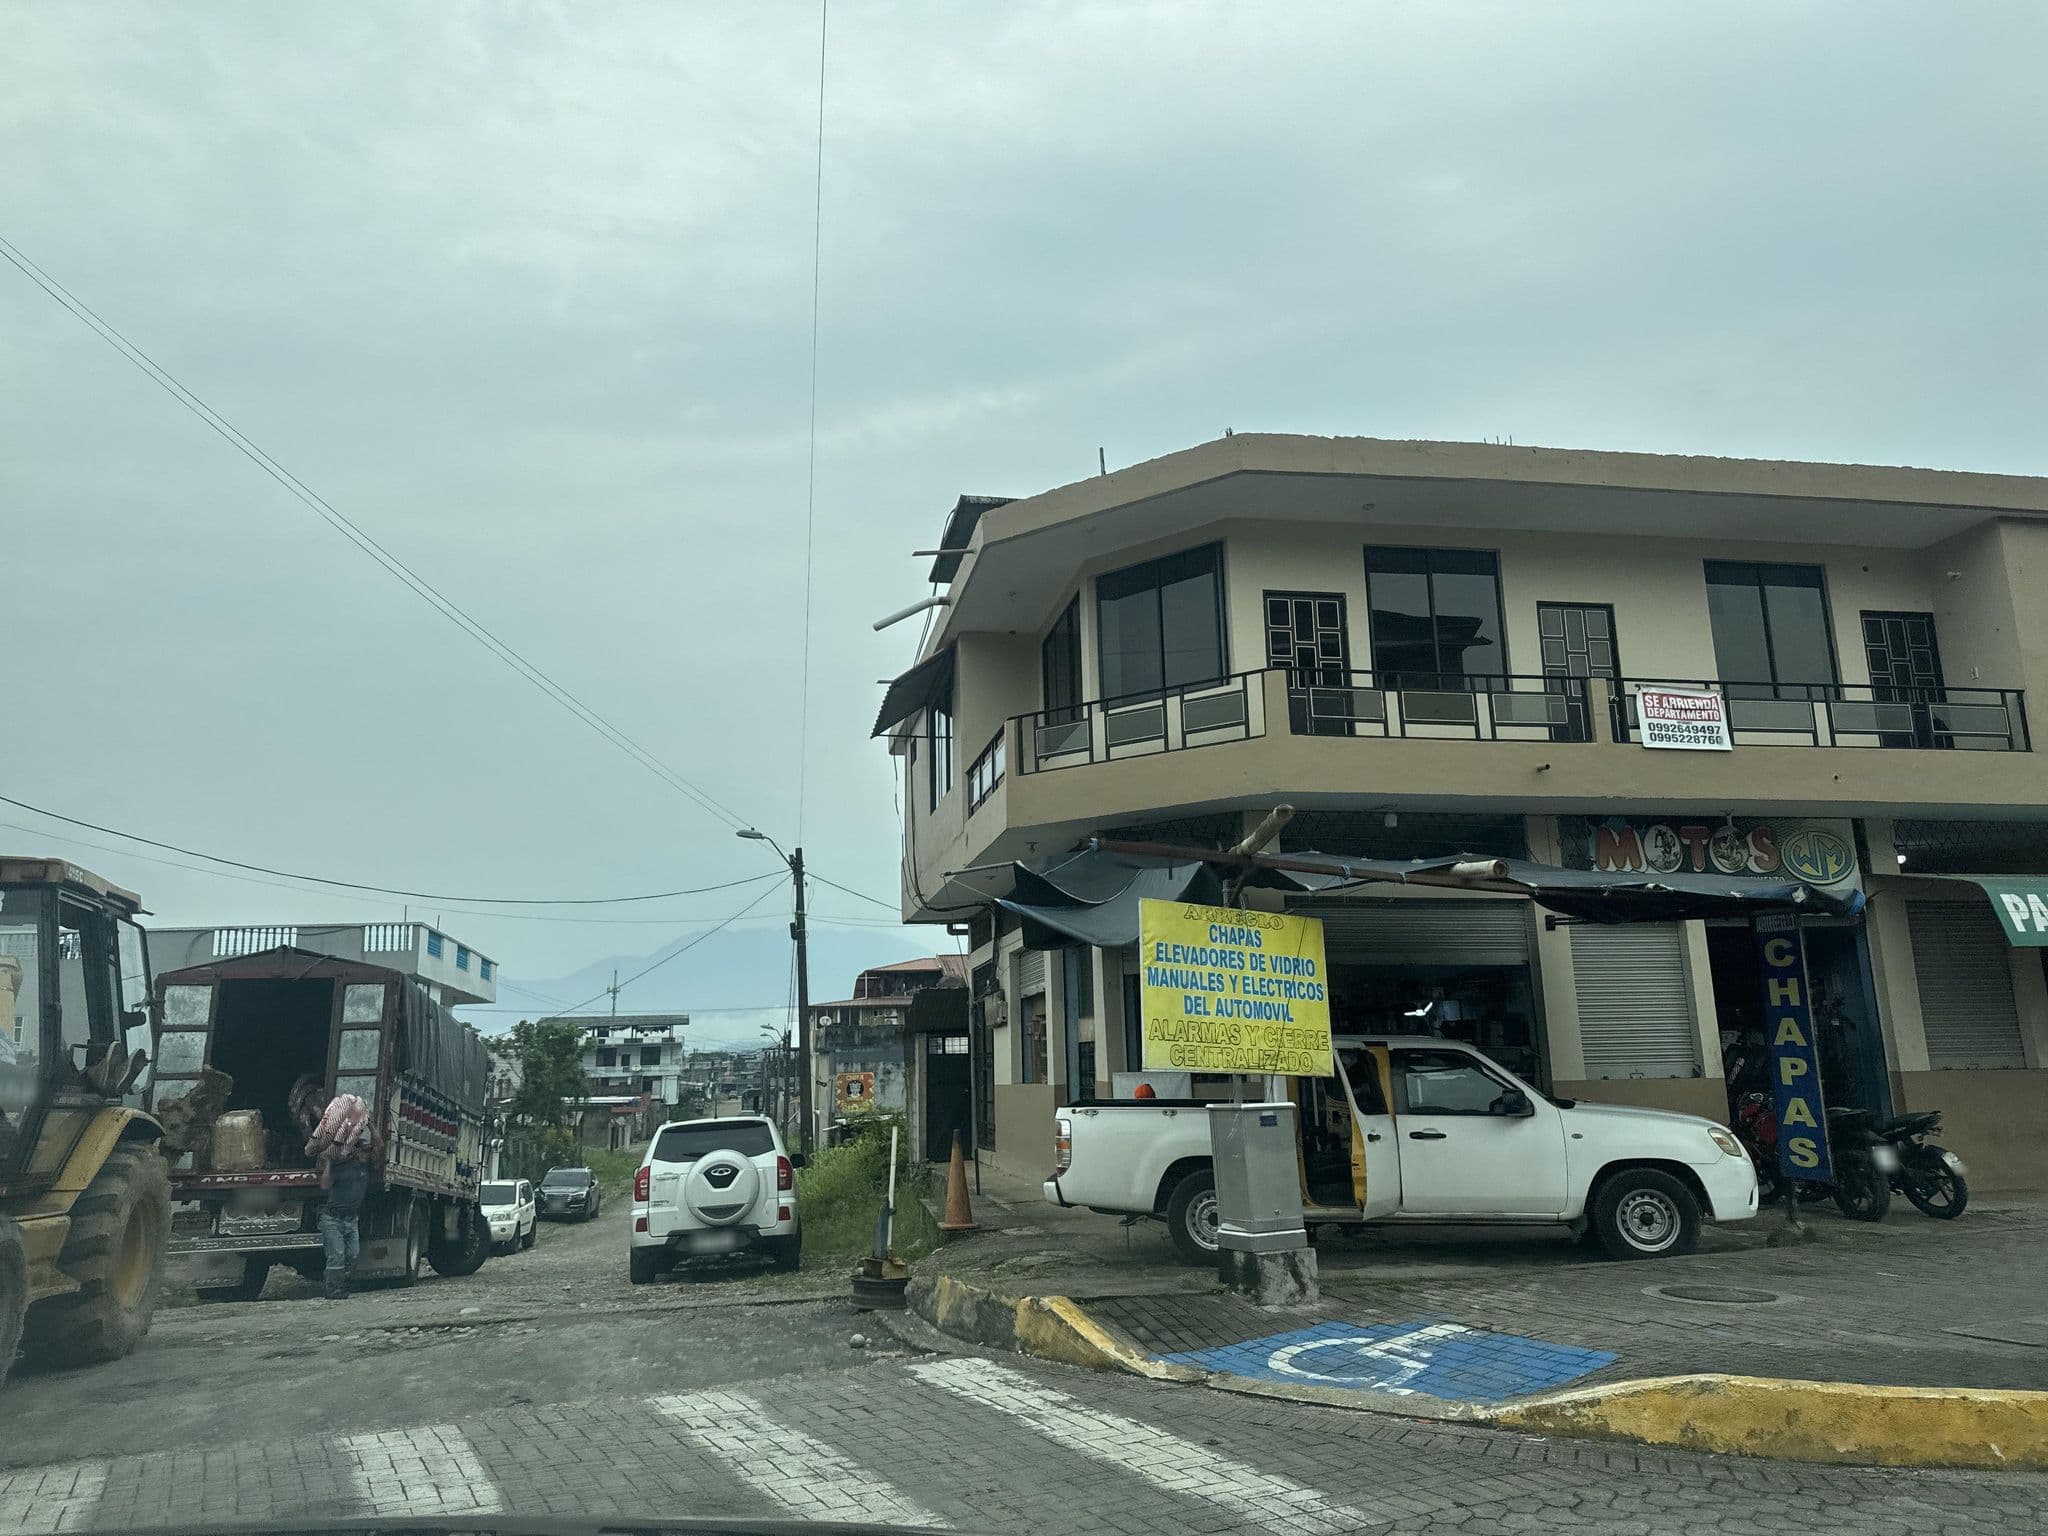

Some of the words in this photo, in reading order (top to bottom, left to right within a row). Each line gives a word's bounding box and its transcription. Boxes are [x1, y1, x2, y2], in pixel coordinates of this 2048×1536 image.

[1645, 695, 1660, 707] SE
[1662, 697, 1719, 710] ARRIENDA
[1647, 707, 1720, 721] DEPARTAMENTO
[1648, 722, 1721, 735] 0992649497
[1595, 824, 1781, 874] MOTOS
[1184, 905, 1285, 931] ARREGLO
[2000, 893, 2048, 932] PA
[1209, 924, 1262, 948] CHAPAS
[1155, 942, 1245, 970] ELEVADORES
[1250, 953, 1266, 972] DE
[1270, 955, 1316, 977] VIDRIO
[1147, 967, 1225, 992] MANUALES
[1229, 975, 1239, 993] Y
[1243, 978, 1324, 1001] ELECTRICOS
[1184, 995, 1211, 1016] DEL
[1216, 999, 1294, 1022] AUTOMOVIL
[1149, 1018, 1241, 1045] ALARMAS
[1245, 1025, 1260, 1047] Y
[1263, 1026, 1330, 1051] CIERRE
[1170, 1044, 1314, 1073] CENTRALIZADO
[1764, 938, 1820, 1169] CHAPAS
